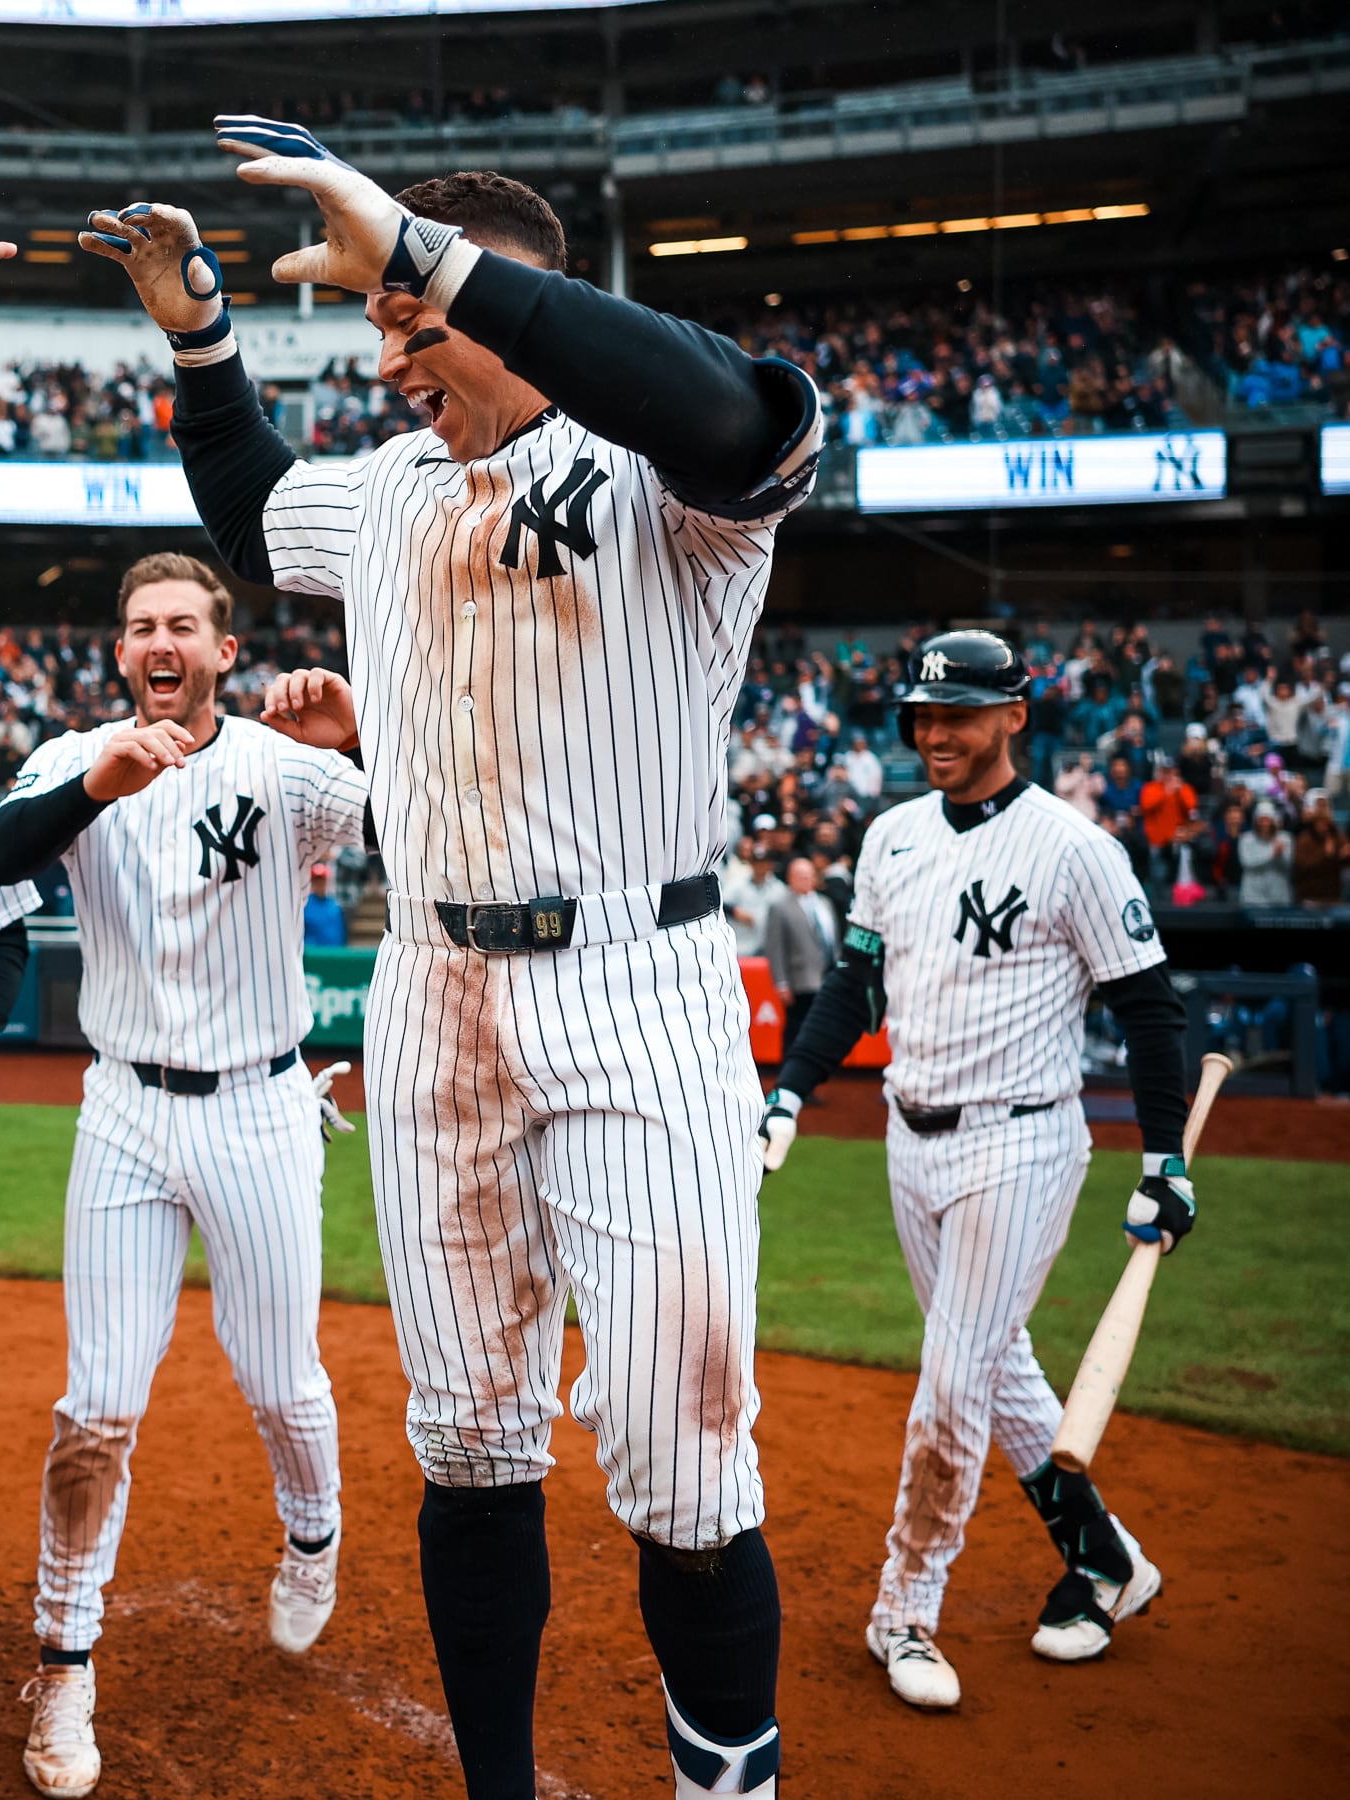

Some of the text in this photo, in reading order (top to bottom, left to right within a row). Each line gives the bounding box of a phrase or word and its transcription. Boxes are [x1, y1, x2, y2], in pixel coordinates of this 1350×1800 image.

[1003, 443, 1075, 493] WIN
[499, 457, 611, 580] NY
[920, 650, 949, 681] NY
[193, 796, 267, 883] NY
[535, 912, 562, 939] 99
[953, 879, 1030, 958] NY
